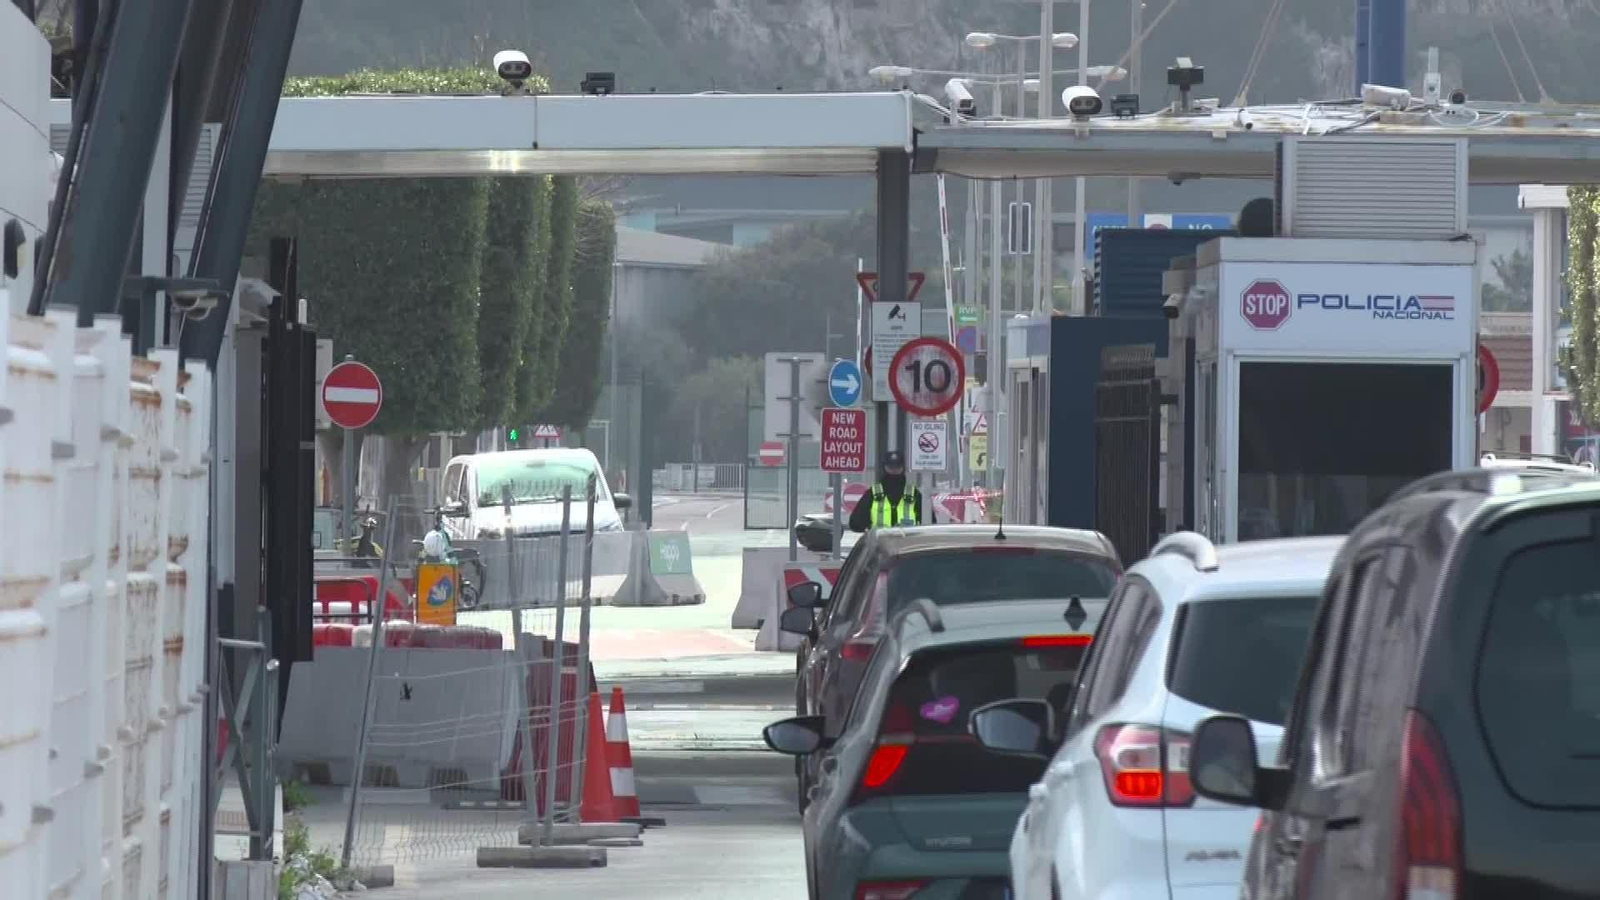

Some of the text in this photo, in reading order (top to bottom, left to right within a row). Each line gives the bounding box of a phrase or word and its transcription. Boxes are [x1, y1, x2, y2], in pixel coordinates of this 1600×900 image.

[1246, 293, 1286, 316] STOP
[1297, 293, 1422, 310] POLICIA
[1373, 310, 1455, 320] NACIONAL
[905, 358, 951, 393] 10
[831, 411, 856, 424] NEW
[829, 427, 858, 439] ROAD
[823, 441, 863, 453] LAYOUT
[825, 456, 860, 468] AHEAD
